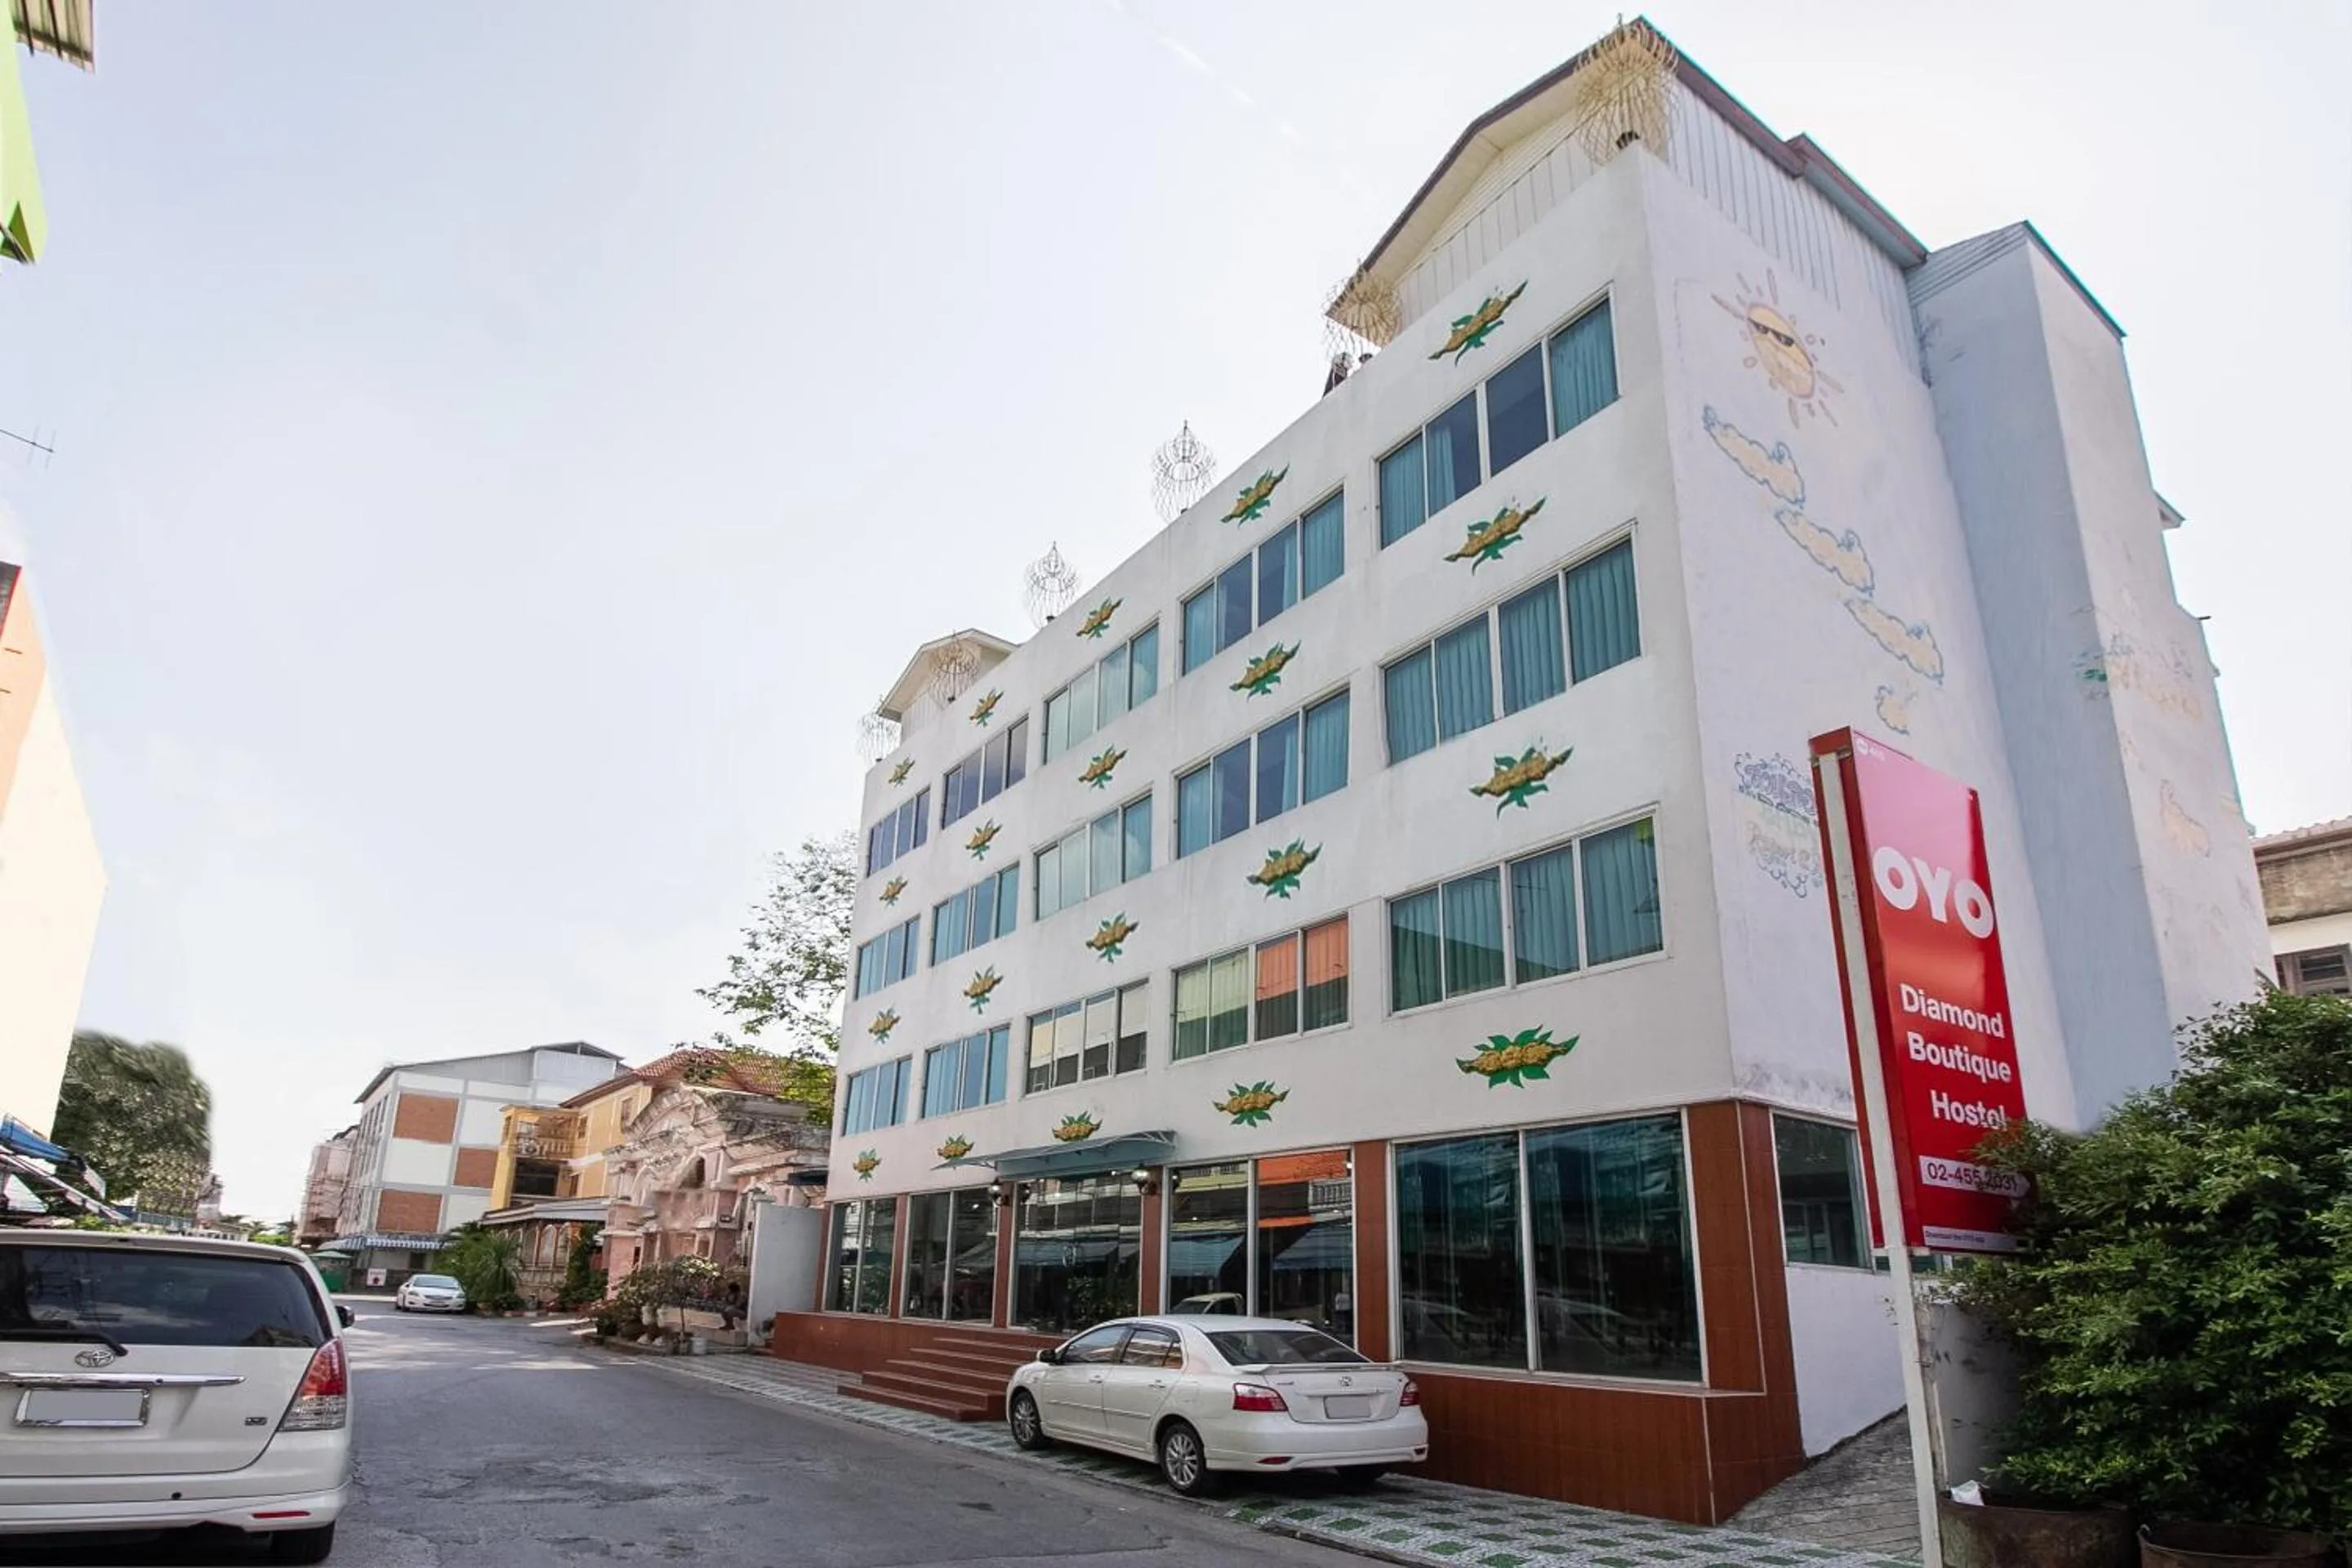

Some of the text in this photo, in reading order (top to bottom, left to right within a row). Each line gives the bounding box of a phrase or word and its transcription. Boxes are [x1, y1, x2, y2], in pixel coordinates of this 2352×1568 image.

[1873, 846, 1993, 939] OYO
[1900, 982, 2005, 1039] Diamond
[1907, 1031, 2011, 1083] Boutique
[1930, 1089, 2007, 1131] Hostel
